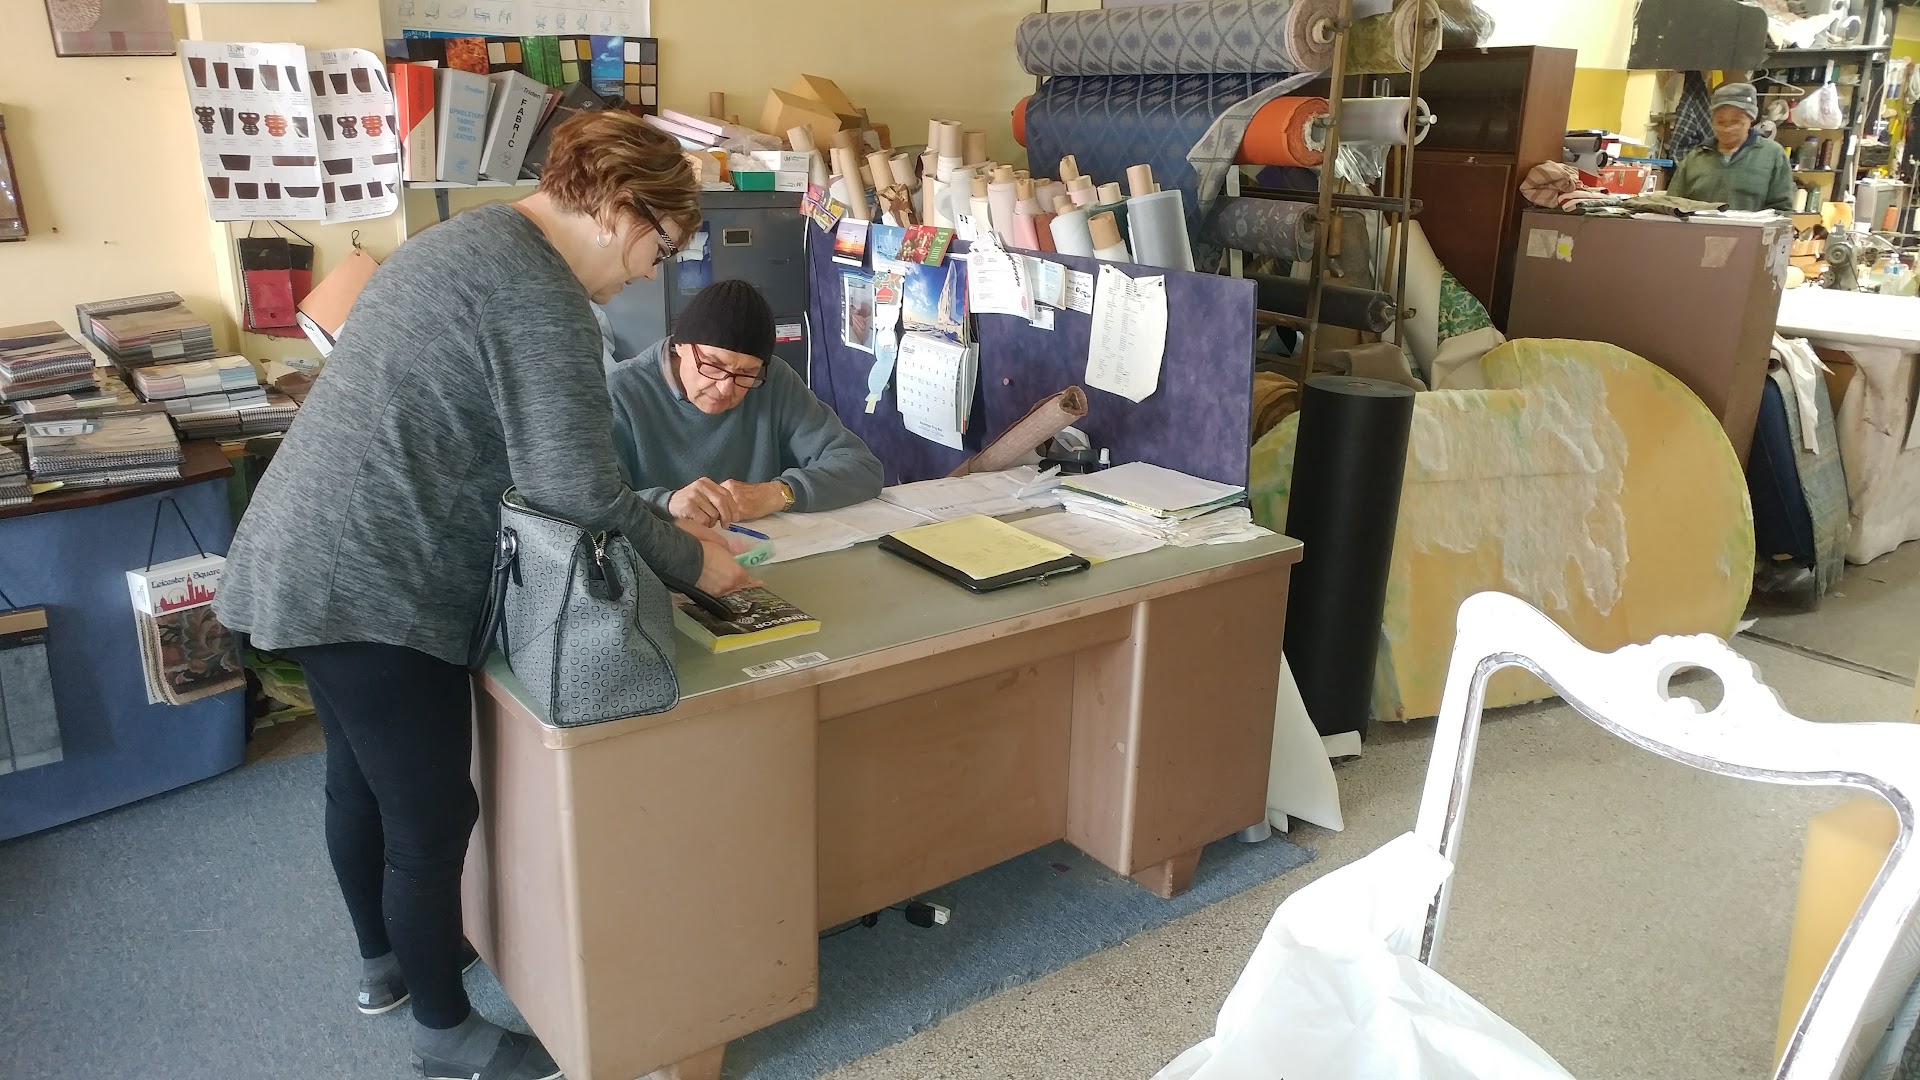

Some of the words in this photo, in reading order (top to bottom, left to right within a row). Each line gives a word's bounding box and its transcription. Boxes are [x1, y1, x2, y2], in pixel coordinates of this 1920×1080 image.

[523, 86, 542, 100] Triden
[508, 97, 528, 149] FABRIC
[750, 552, 768, 565] 20
[151, 576, 186, 589] Leicester
[193, 568, 221, 580] Square
[753, 613, 812, 630] WINDSOR
